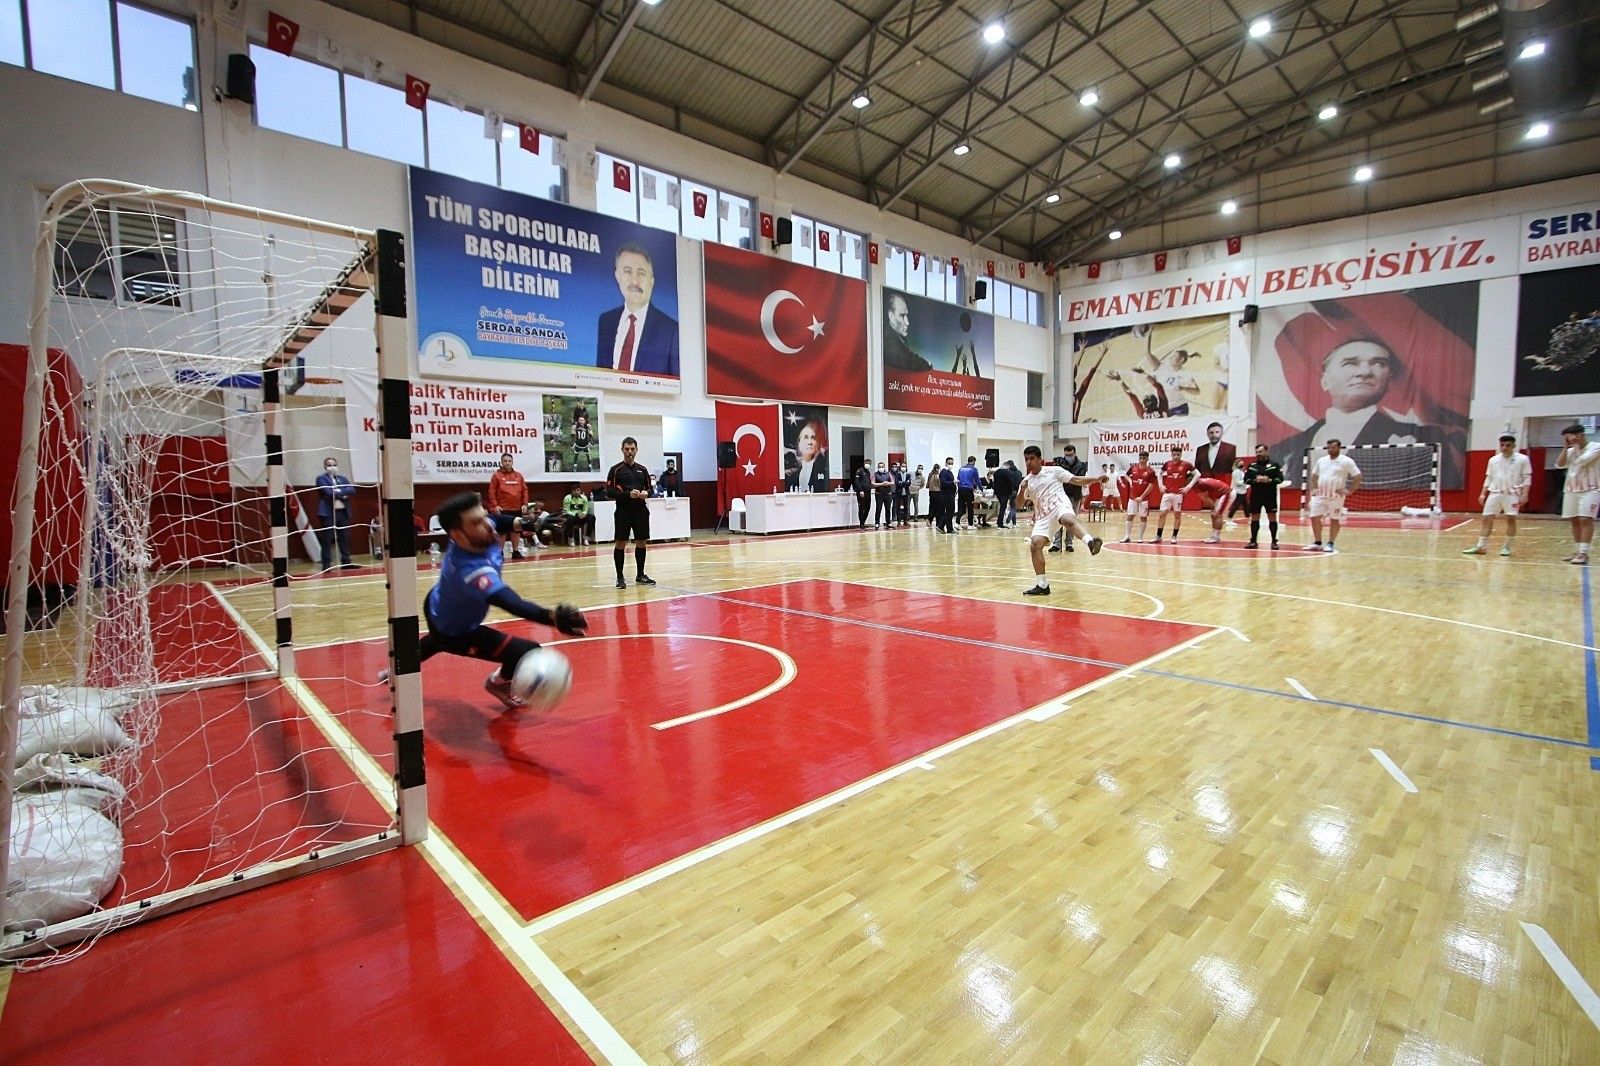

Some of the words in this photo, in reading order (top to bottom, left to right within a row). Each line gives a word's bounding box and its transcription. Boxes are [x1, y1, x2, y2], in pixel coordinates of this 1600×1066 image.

[424, 194, 474, 226] TÜM
[478, 207, 601, 254] SPORCULARA
[464, 233, 572, 275] BAŞARILAR
[481, 265, 560, 299] DİLERİM
[1067, 272, 1251, 322] EMANETİNİN
[1261, 235, 1496, 294] BEKÇİSİYİZ.
[477, 320, 522, 335] SERDAR
[524, 326, 567, 340] SANDAL
[448, 386, 507, 403] Tahirler
[431, 403, 525, 421] Turnuvasına
[428, 420, 462, 435] Tüm
[466, 422, 537, 438] Takımlara
[577, 430, 586, 440] 10
[1099, 431, 1119, 442] TÜM
[1122, 429, 1188, 441] SPORCULARA
[463, 440, 522, 454] Dilerim.
[1093, 445, 1145, 457] BAŞARILAR
[436, 460, 469, 468] SERDAR
